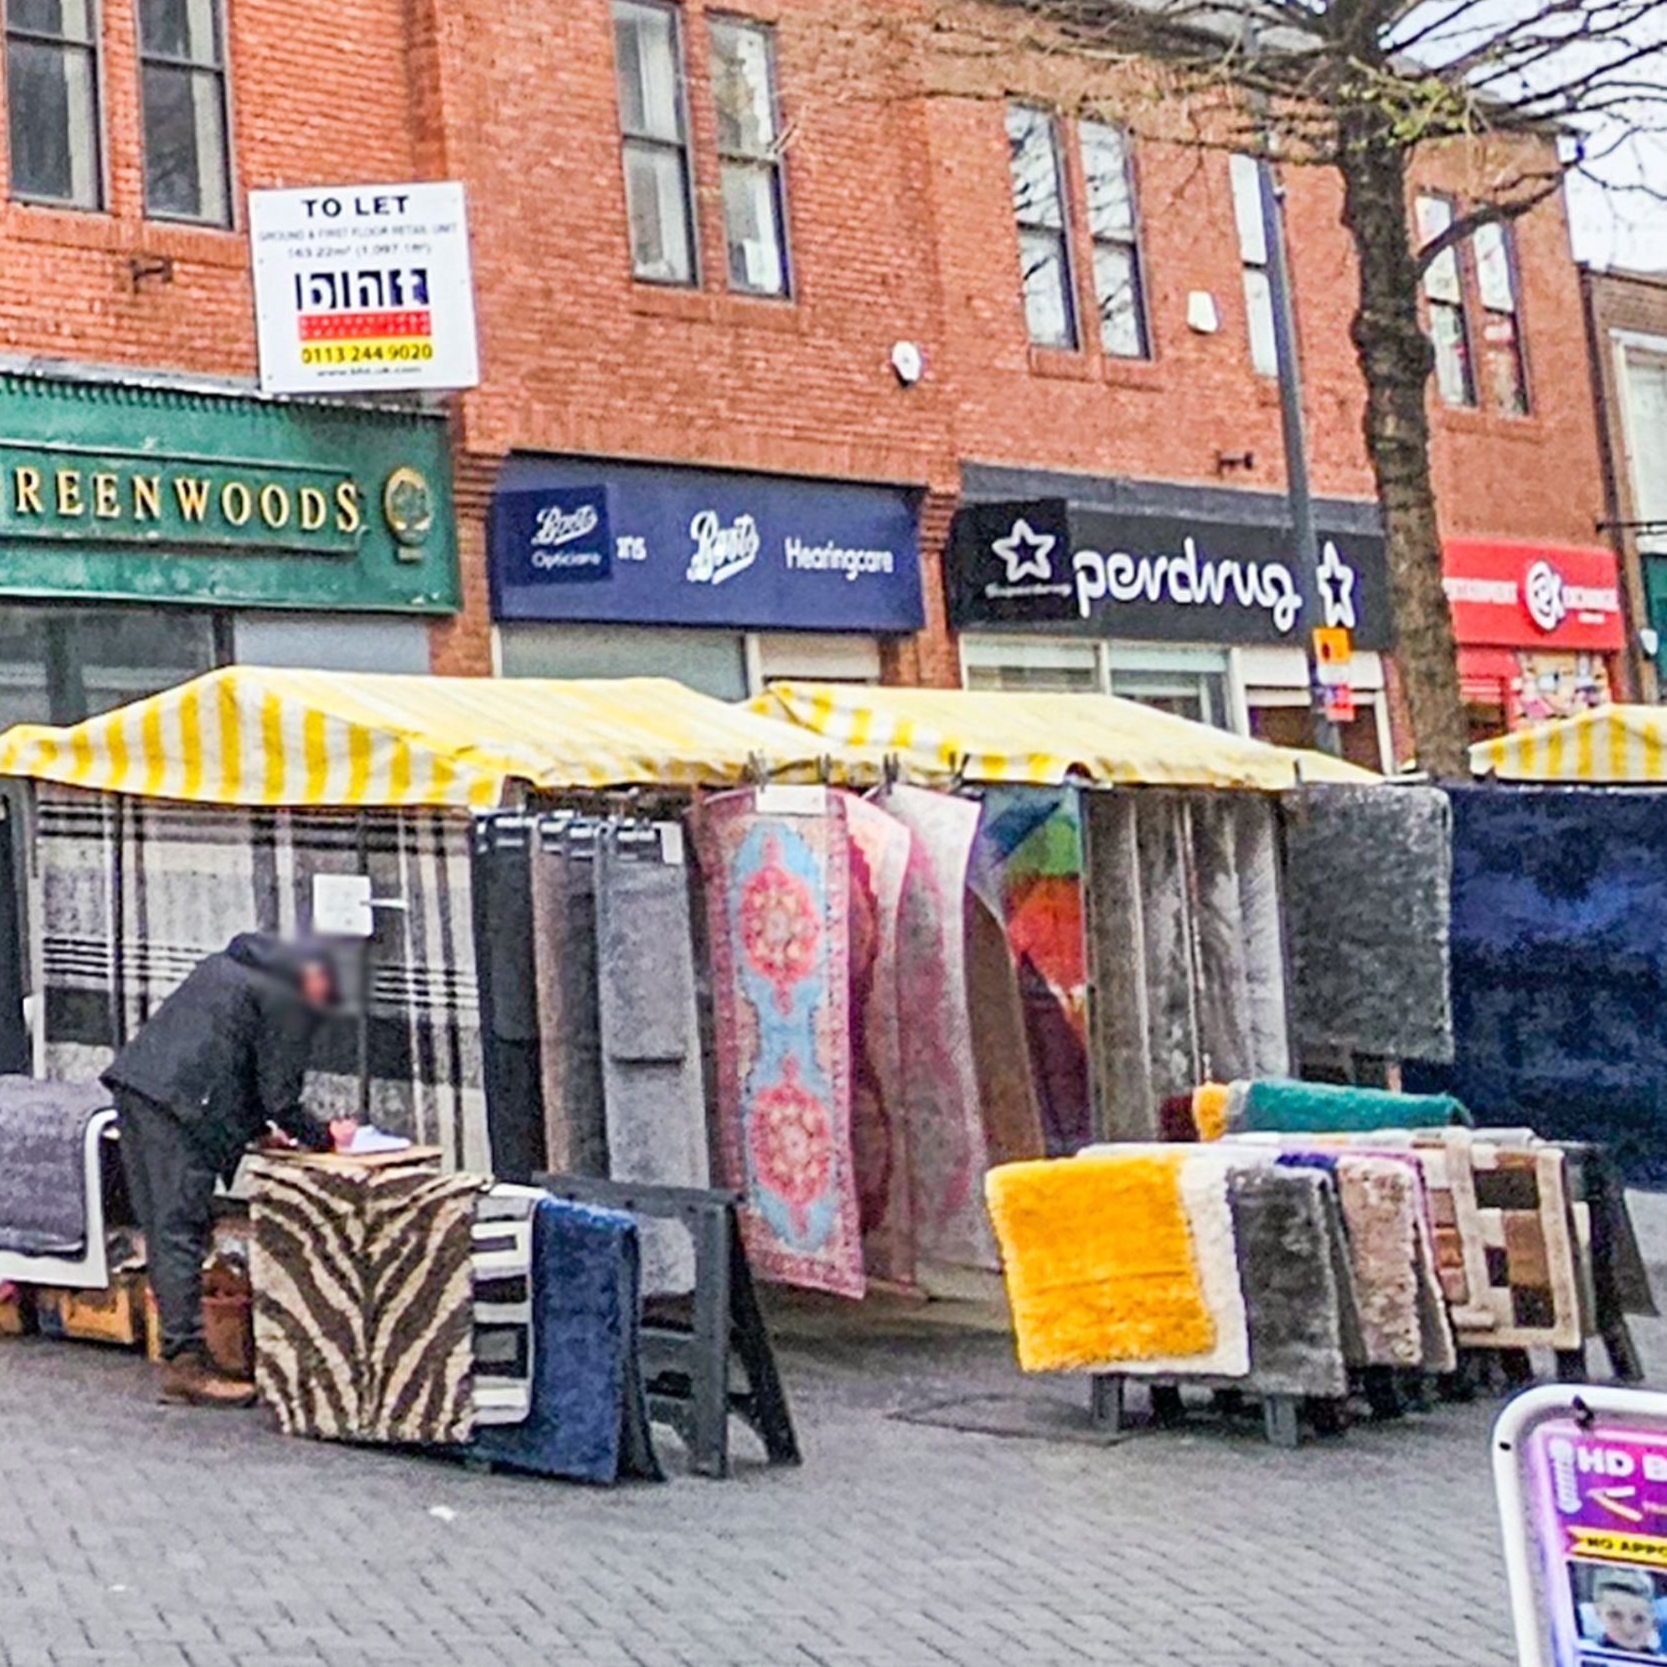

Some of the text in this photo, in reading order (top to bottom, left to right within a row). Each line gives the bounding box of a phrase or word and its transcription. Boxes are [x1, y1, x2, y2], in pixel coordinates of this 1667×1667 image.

[301, 195, 409, 218] TO LET
[301, 343, 433, 364] 0113 244 9020
[530, 504, 599, 546] Boots
[686, 509, 761, 585] Boots
[783, 537, 894, 581] Hearingcare
[1576, 1445, 1635, 1477] HD
[1587, 1537, 1614, 1551] NO
